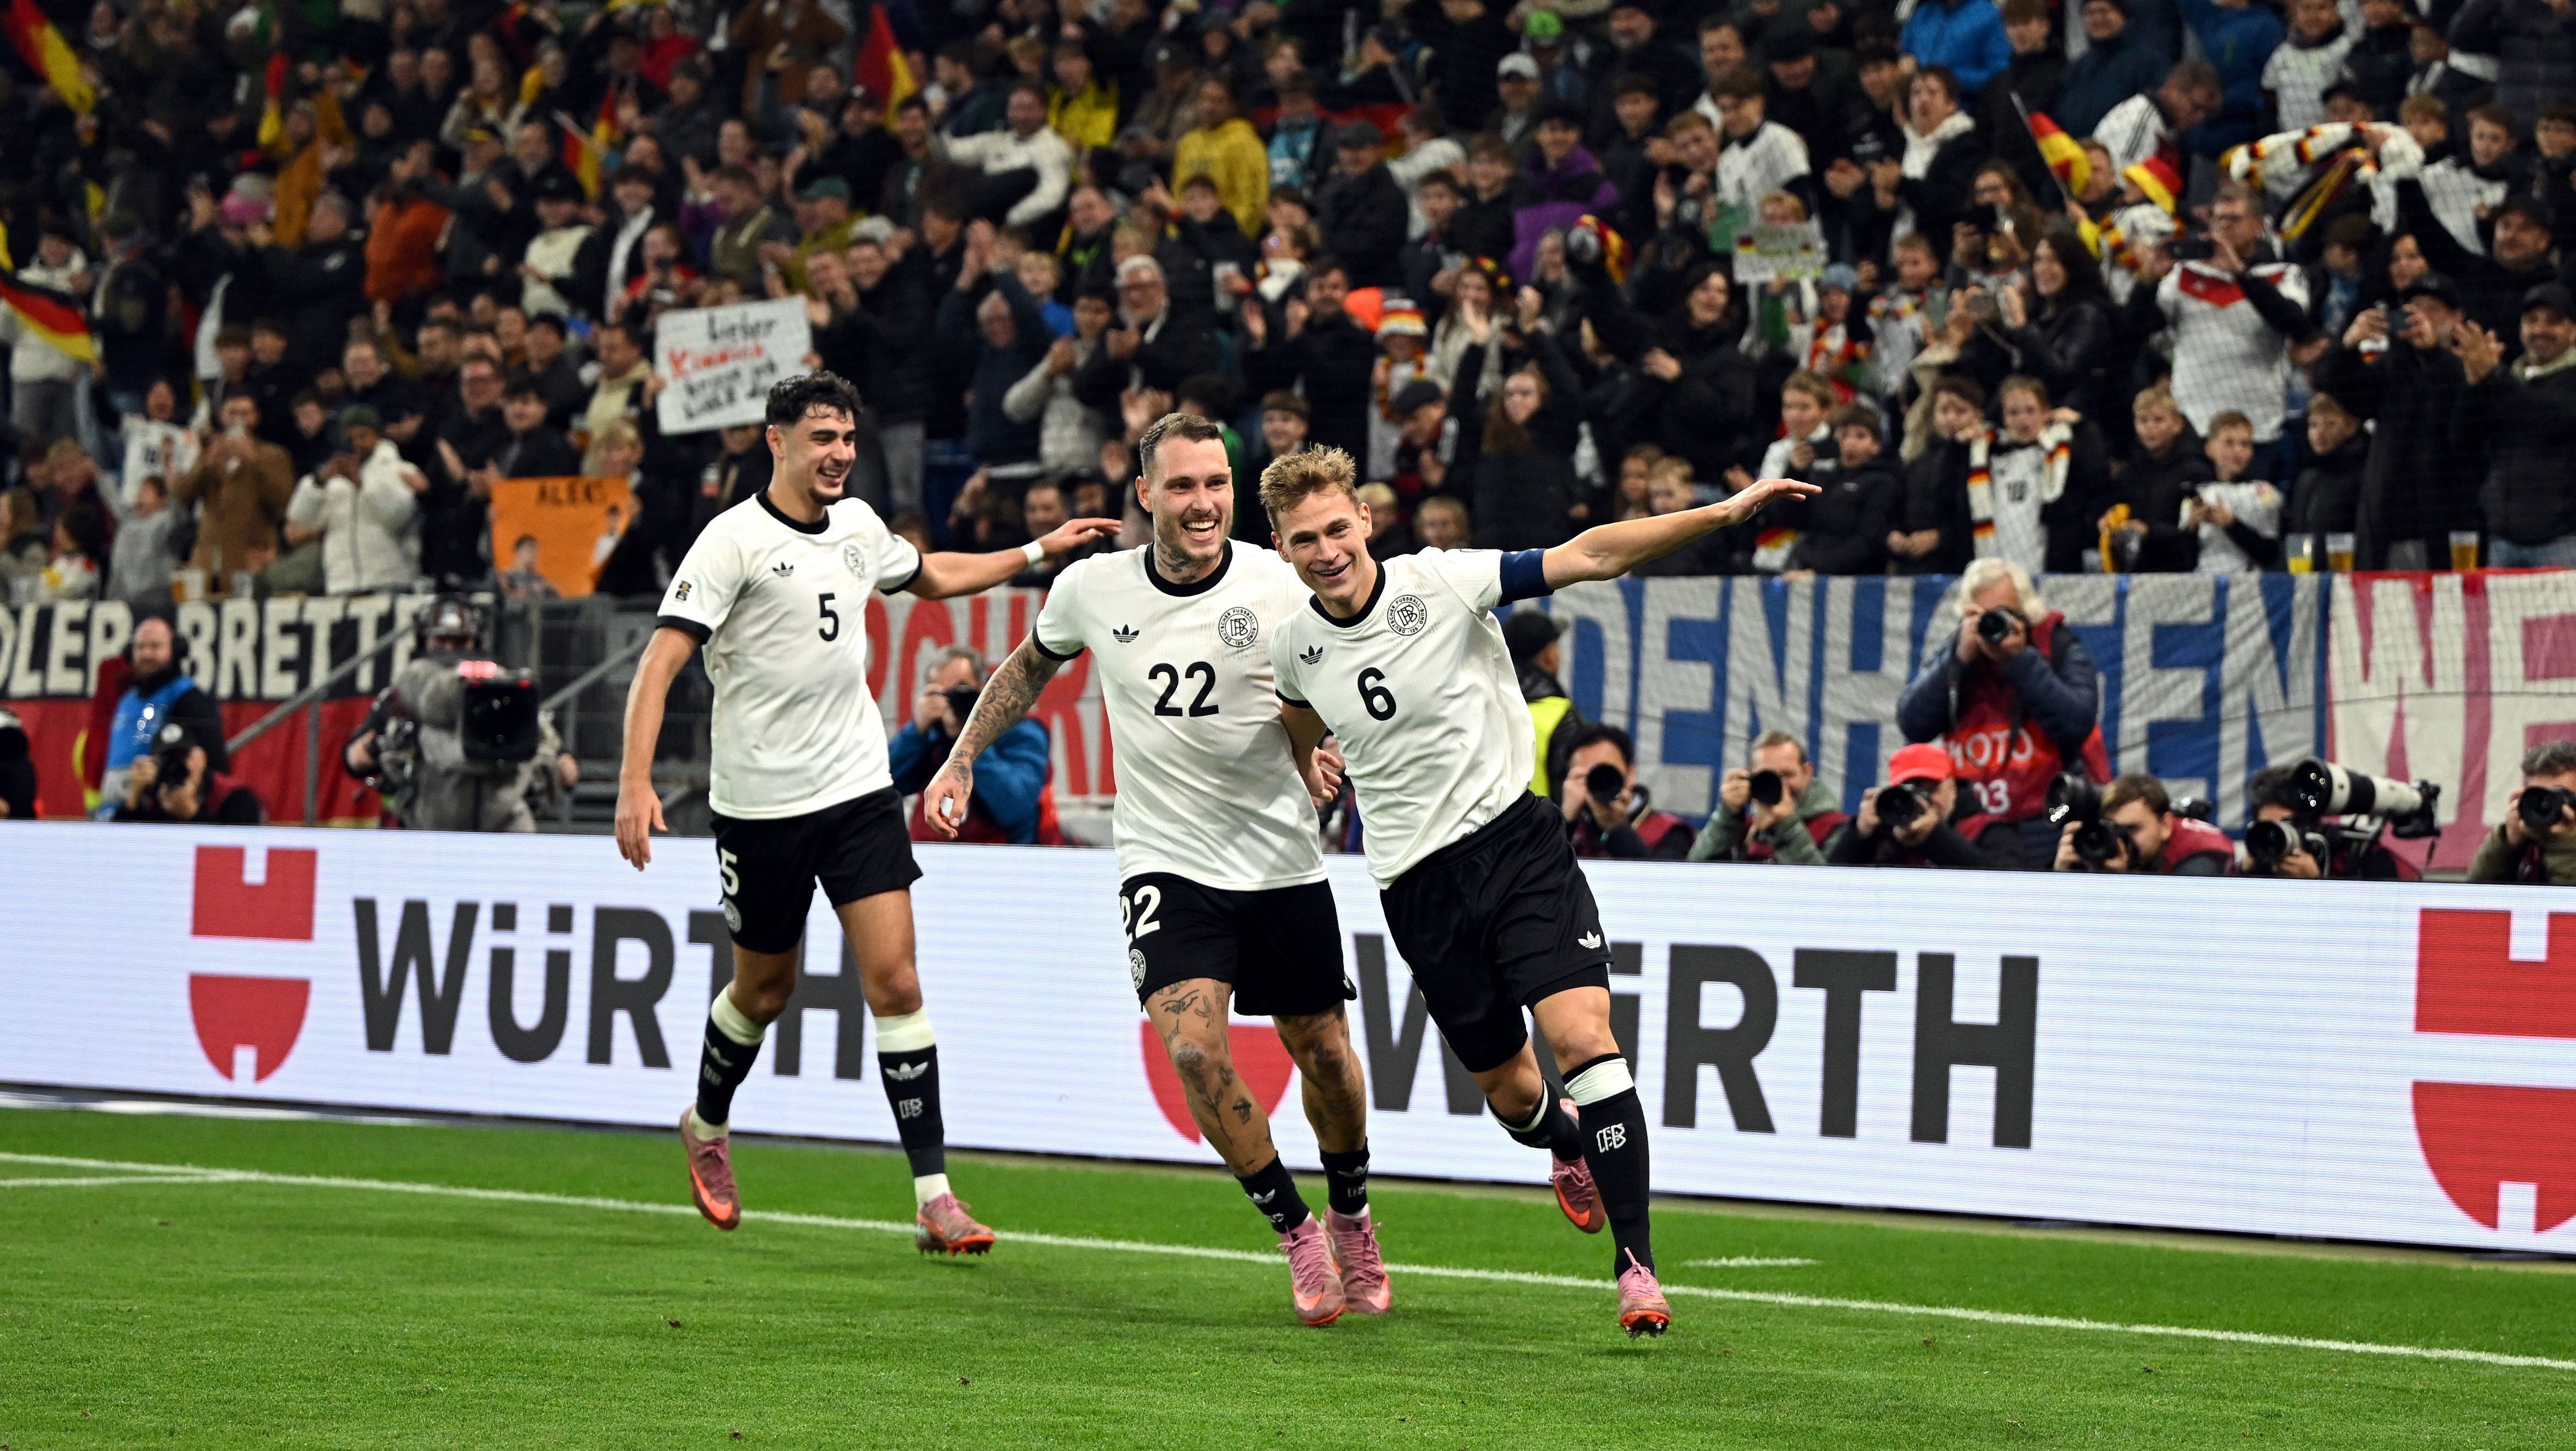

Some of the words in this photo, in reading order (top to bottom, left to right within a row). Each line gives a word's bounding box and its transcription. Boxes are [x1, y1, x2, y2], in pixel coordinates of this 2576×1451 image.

[819, 593, 840, 642] 5
[1148, 661, 1219, 718] 22
[1357, 667, 1397, 721] 6
[720, 847, 740, 896] 5
